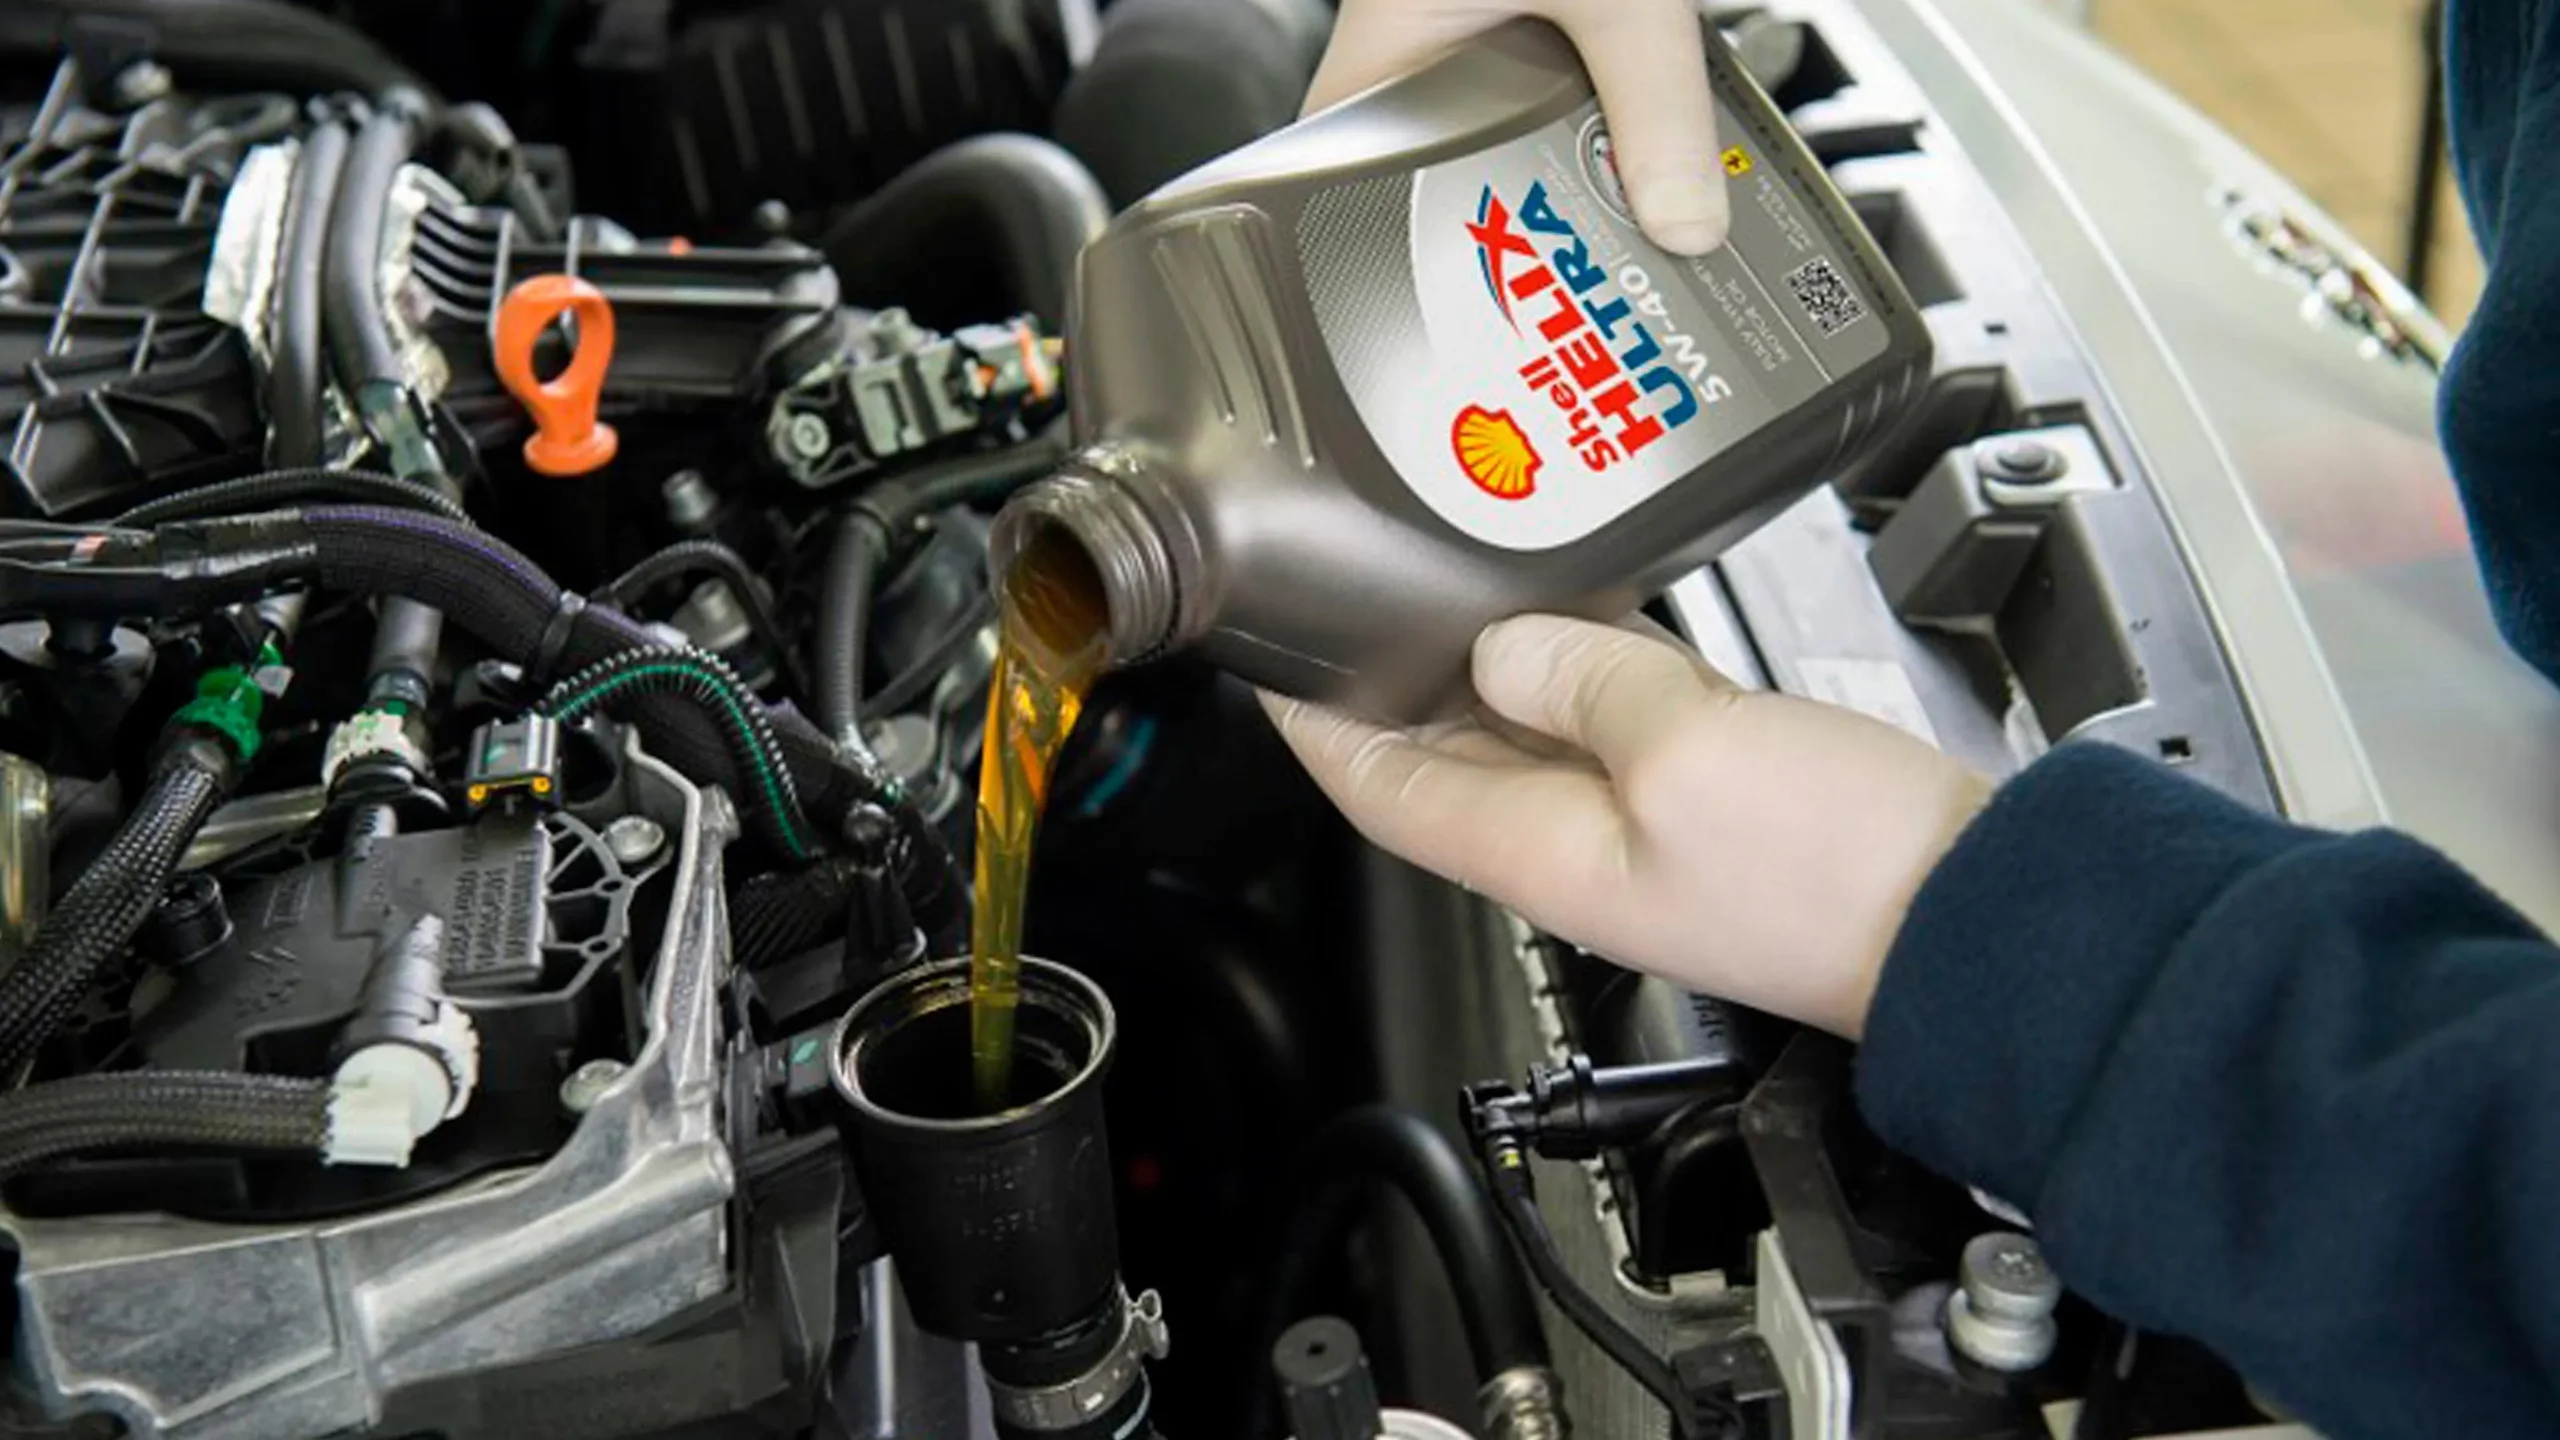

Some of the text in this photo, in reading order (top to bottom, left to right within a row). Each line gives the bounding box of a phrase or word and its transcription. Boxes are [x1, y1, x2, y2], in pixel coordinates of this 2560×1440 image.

[1465, 186, 1666, 460] HELIX
[1519, 179, 1698, 430] ULTRA
[1616, 262, 1733, 404] 5W-40
[1518, 355, 1620, 472] Shell
